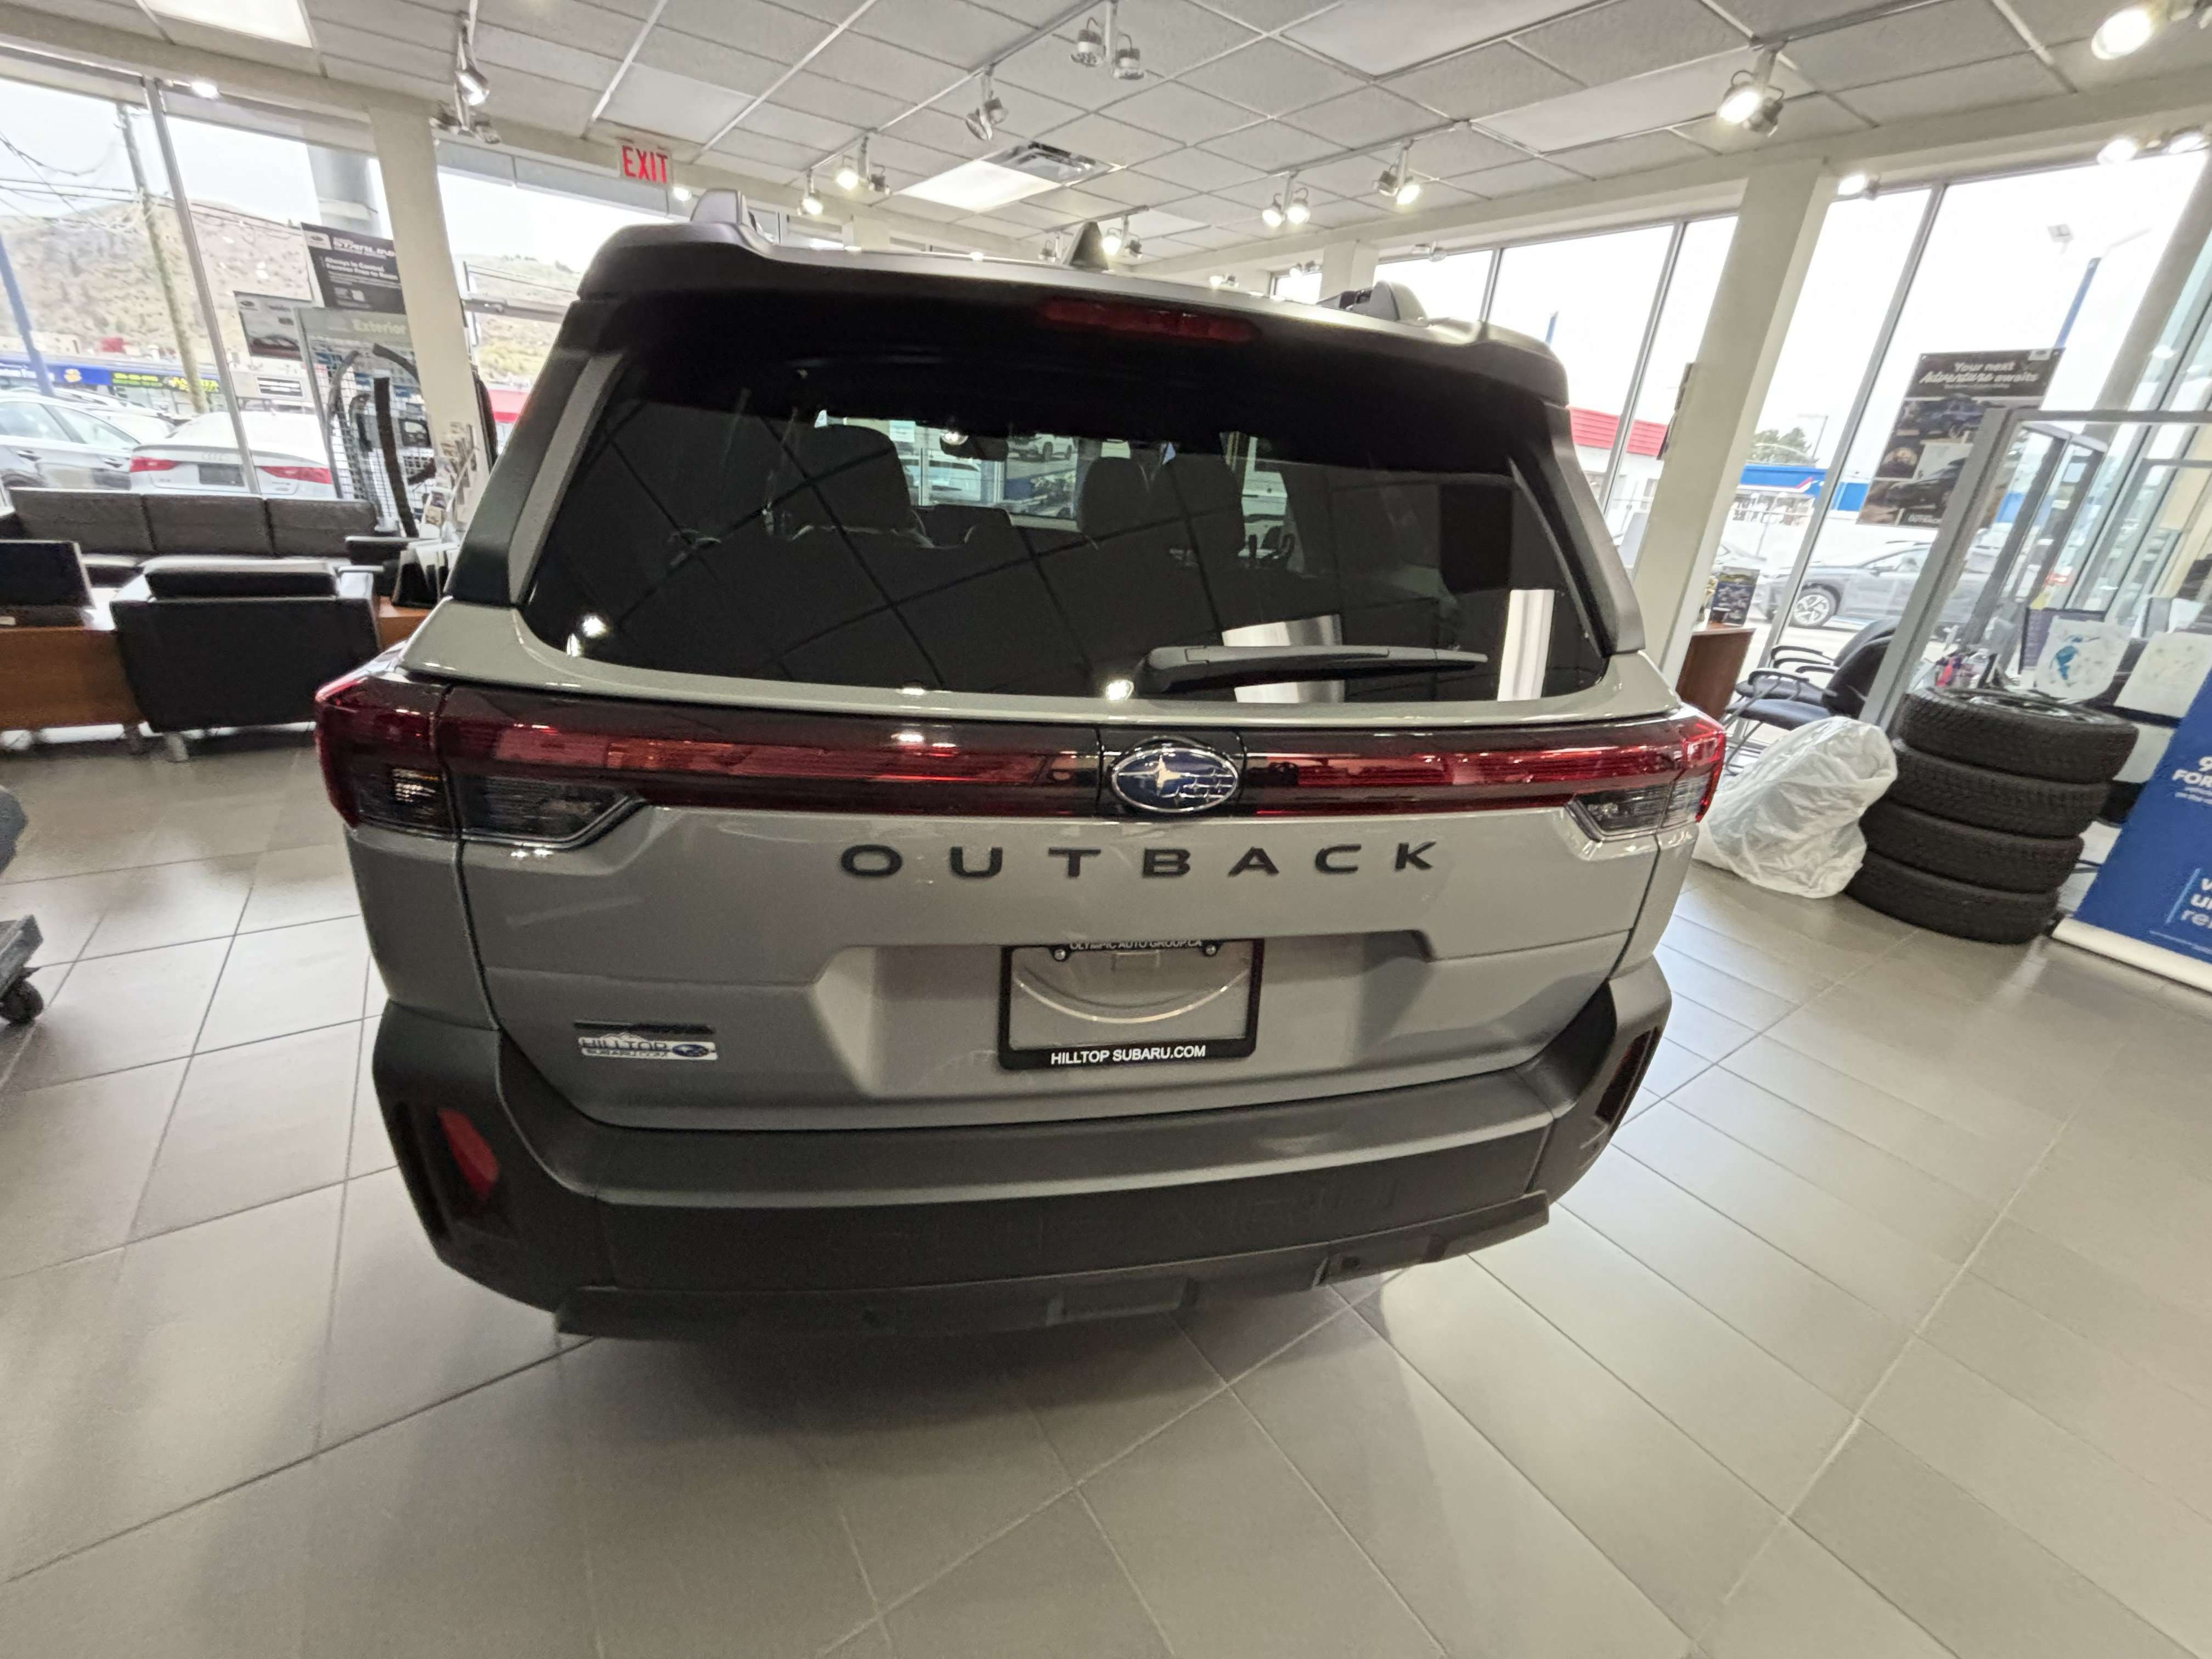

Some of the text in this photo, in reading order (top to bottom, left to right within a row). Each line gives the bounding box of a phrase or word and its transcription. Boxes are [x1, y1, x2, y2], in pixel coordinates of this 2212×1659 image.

[622, 145, 668, 185] EXIT
[352, 318, 406, 335] Exterior
[1954, 360, 2016, 373] Your next
[1919, 370, 2039, 383] Adventure awaits
[840, 840, 1438, 878] OUTBACK
[1118, 940, 1147, 949] AUTO
[582, 1039, 667, 1051] HILLTOP
[1051, 1045, 1206, 1065] HILLTOP SUBARU.COM
